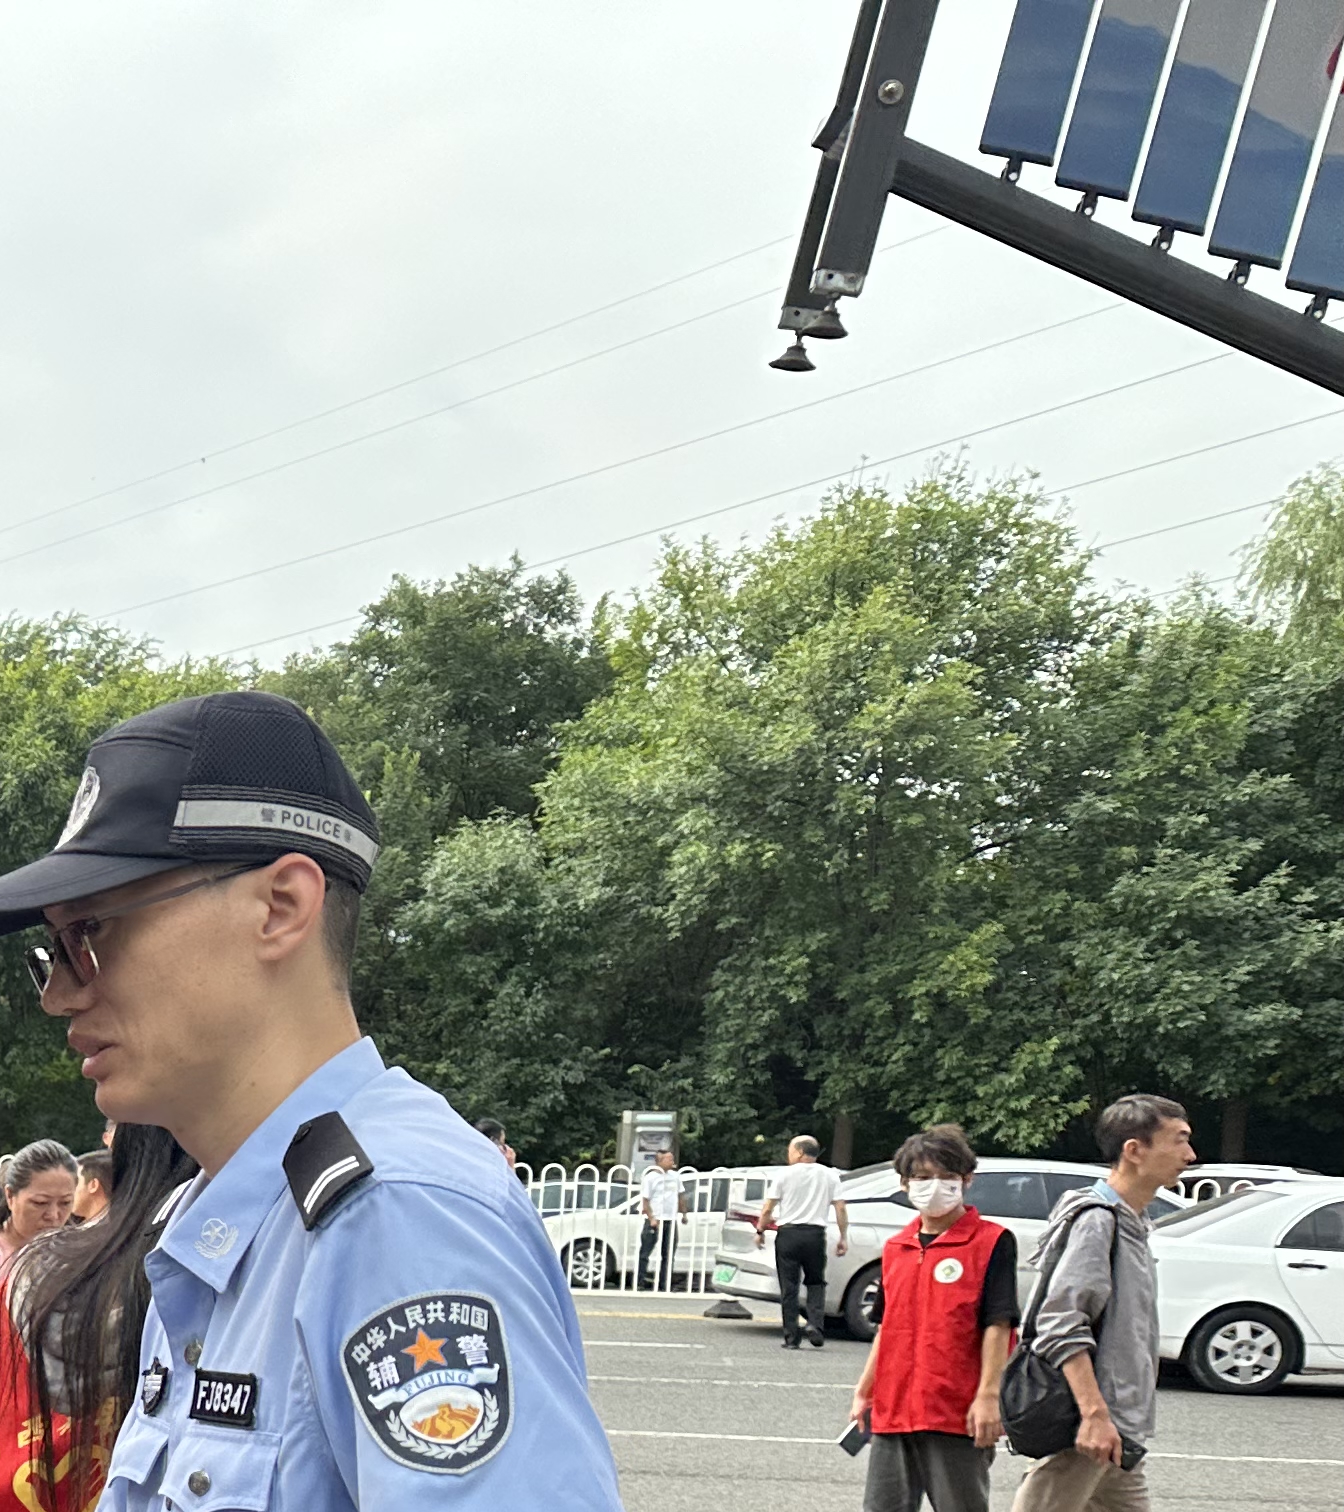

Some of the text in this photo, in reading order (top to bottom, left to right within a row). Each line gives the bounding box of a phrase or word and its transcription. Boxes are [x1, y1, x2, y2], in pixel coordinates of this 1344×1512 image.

[281, 810, 341, 839] POLICE
[351, 1300, 489, 1366] 中华人民共和国
[196, 1380, 251, 1415] FJ8347
[403, 1370, 470, 1396] FUJING
